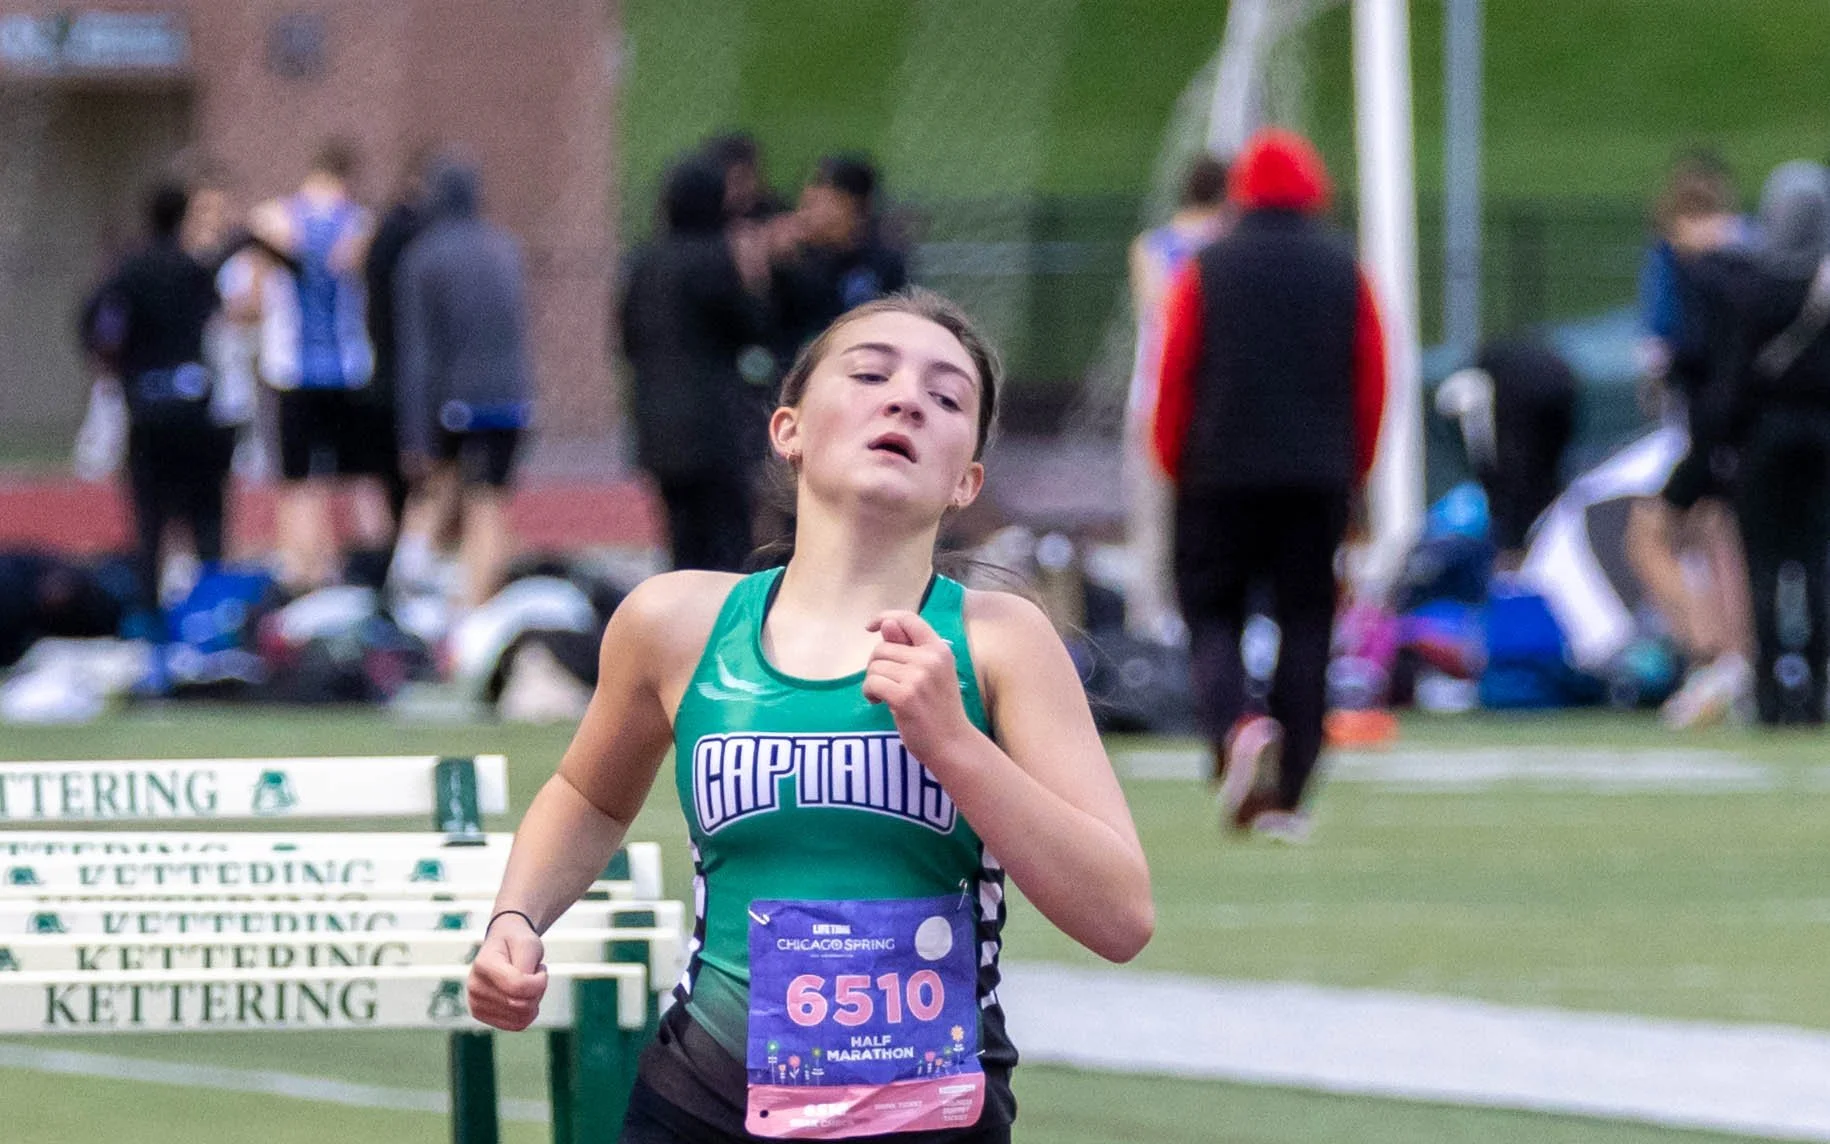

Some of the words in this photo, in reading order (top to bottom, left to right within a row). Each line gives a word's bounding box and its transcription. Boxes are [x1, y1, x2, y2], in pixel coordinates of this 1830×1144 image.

[44, 978, 378, 1024] KETTERING
[786, 969, 945, 1026] 6510
[826, 1046, 914, 1062] MARATHON
[850, 1035, 893, 1048] HALF
